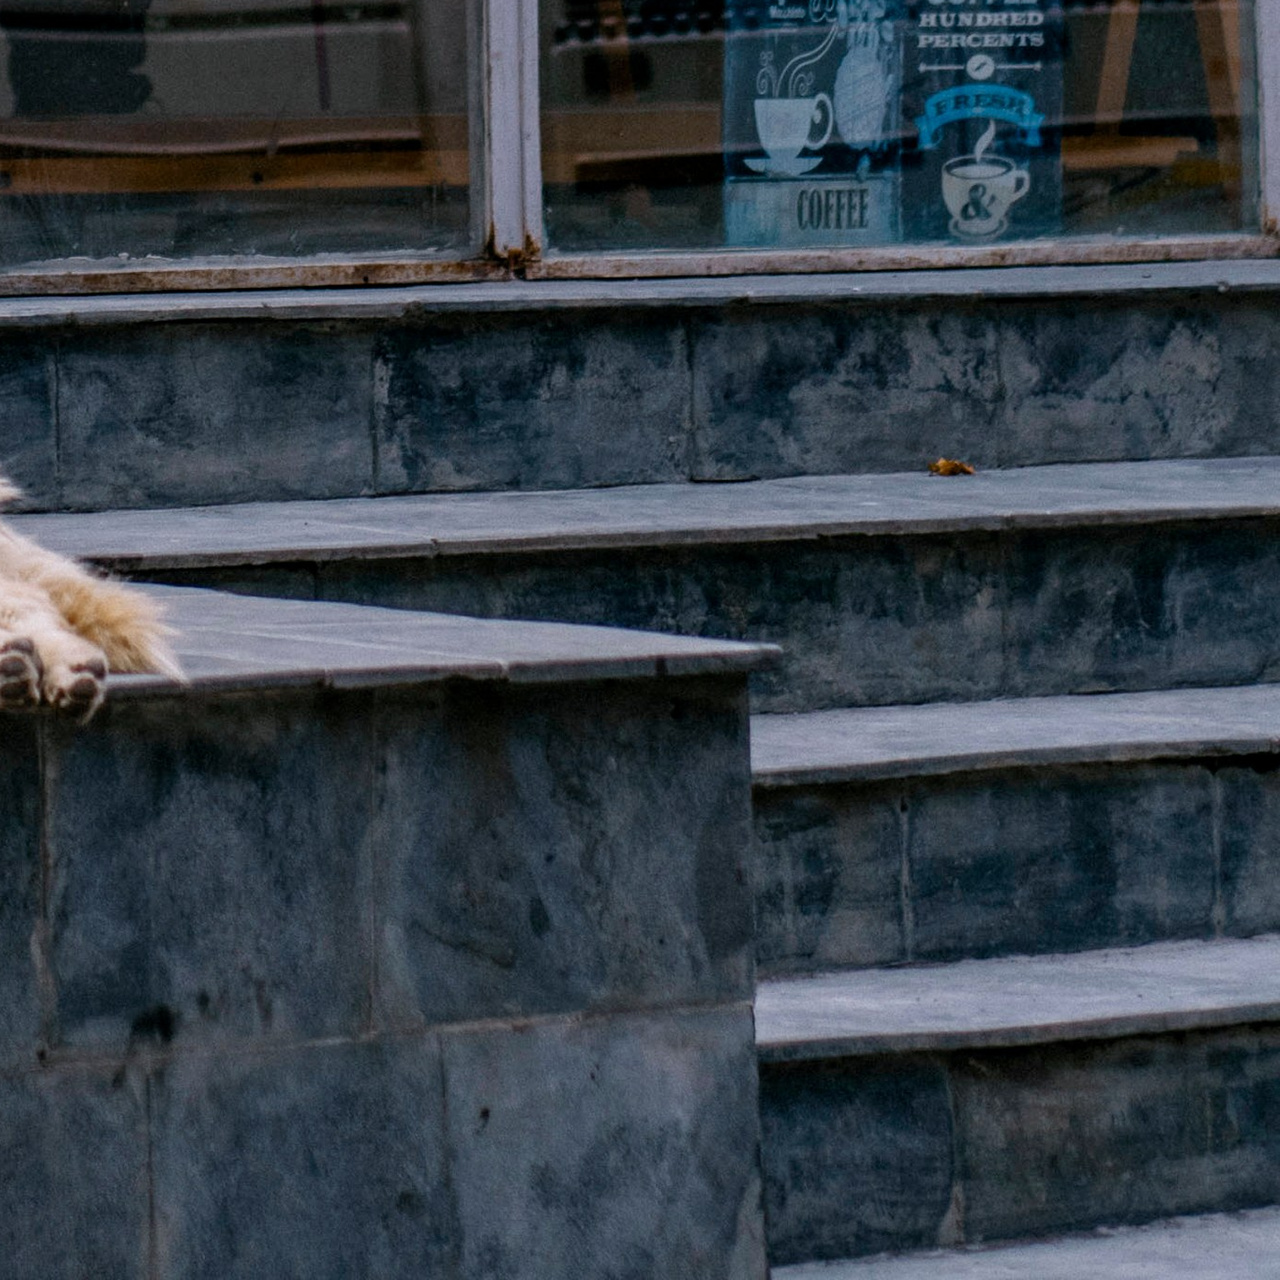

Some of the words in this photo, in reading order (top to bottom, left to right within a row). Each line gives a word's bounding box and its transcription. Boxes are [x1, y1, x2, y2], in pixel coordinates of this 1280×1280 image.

[919, 12, 1045, 28] HUNDRED
[917, 32, 1045, 49] PERCENTS
[934, 93, 1031, 116] FRESH
[797, 188, 869, 231] COFFEE
[960, 184, 996, 222] &
